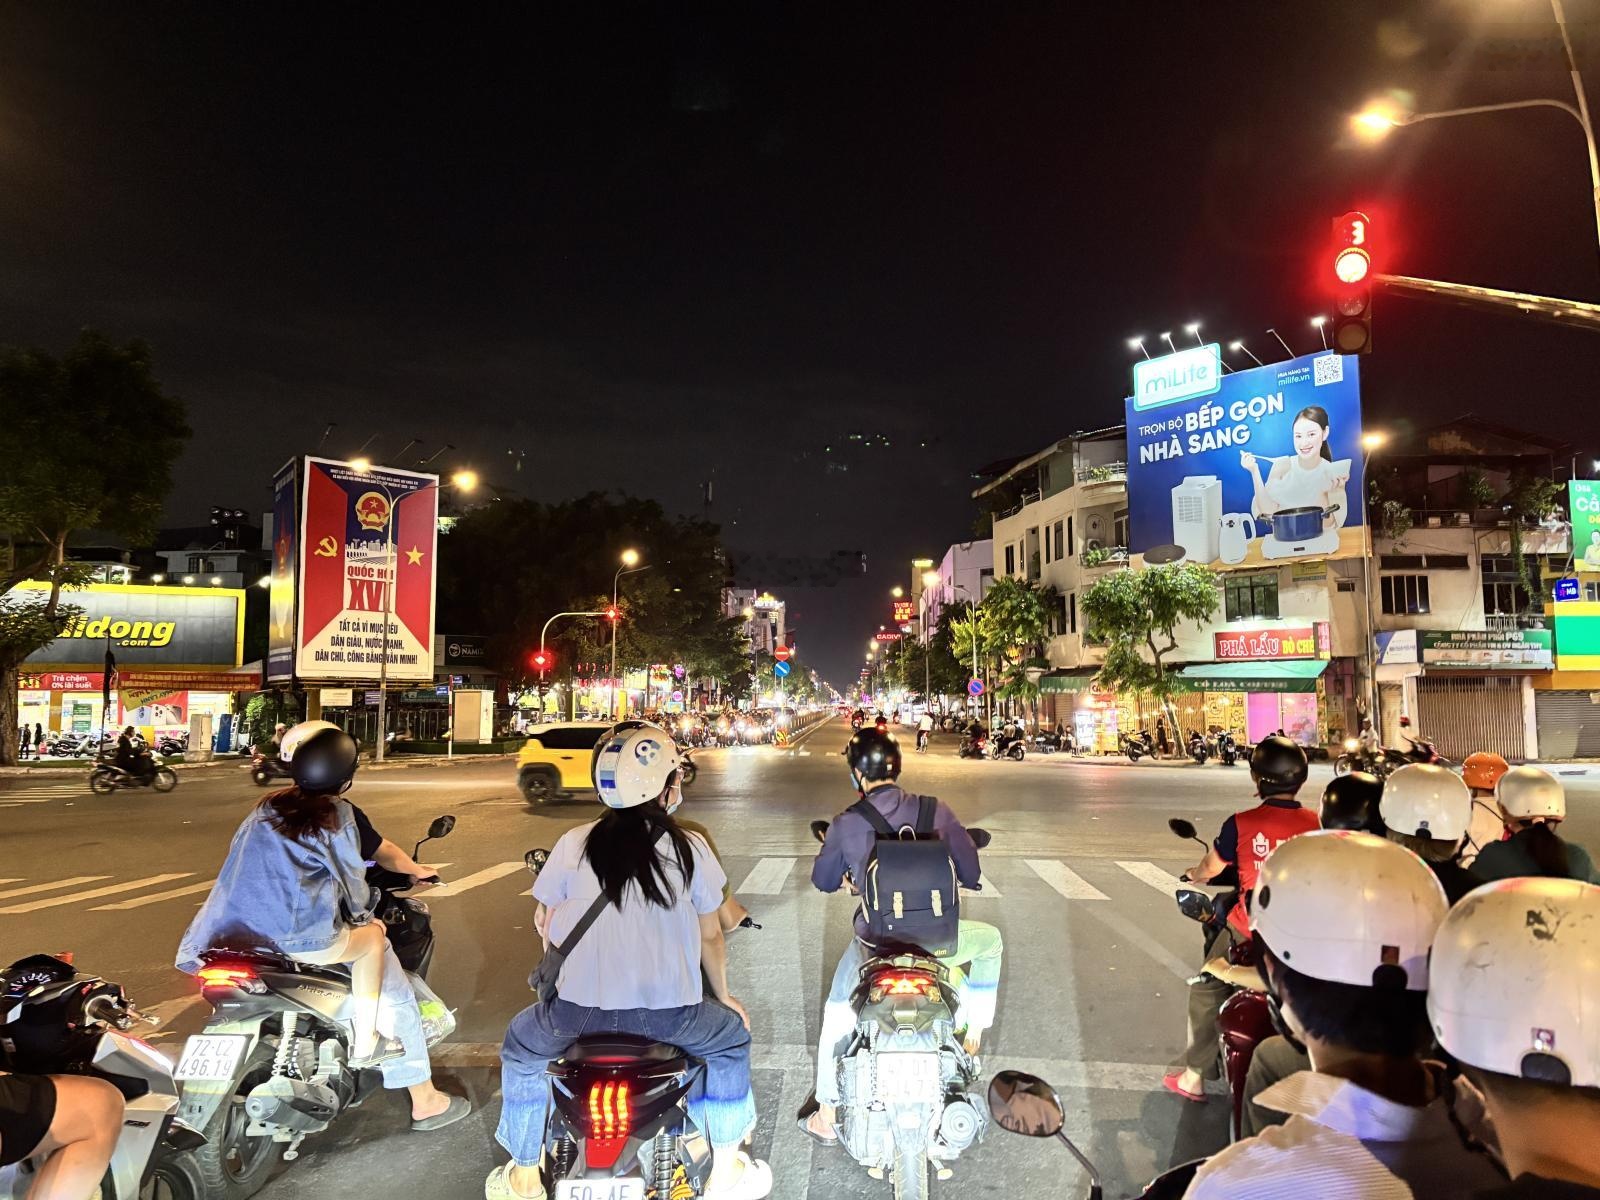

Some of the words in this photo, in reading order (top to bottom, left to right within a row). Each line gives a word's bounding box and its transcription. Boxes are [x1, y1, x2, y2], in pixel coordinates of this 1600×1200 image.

[1145, 363, 1210, 394] miLife
[1278, 374, 1310, 386] milife.vn
[1138, 422, 1166, 437] TRỌN
[1168, 417, 1183, 432] BỘ
[1185, 402, 1225, 432] BẾP
[1229, 392, 1284, 423] GỌN
[1139, 436, 1184, 464] NHÀ
[1188, 424, 1251, 453] SANG
[348, 563, 374, 578] QUỐC
[339, 618, 350, 632] TẤT
[117, 639, 148, 647] .com
[331, 635, 345, 647] DÂN
[315, 649, 329, 661] DÂN
